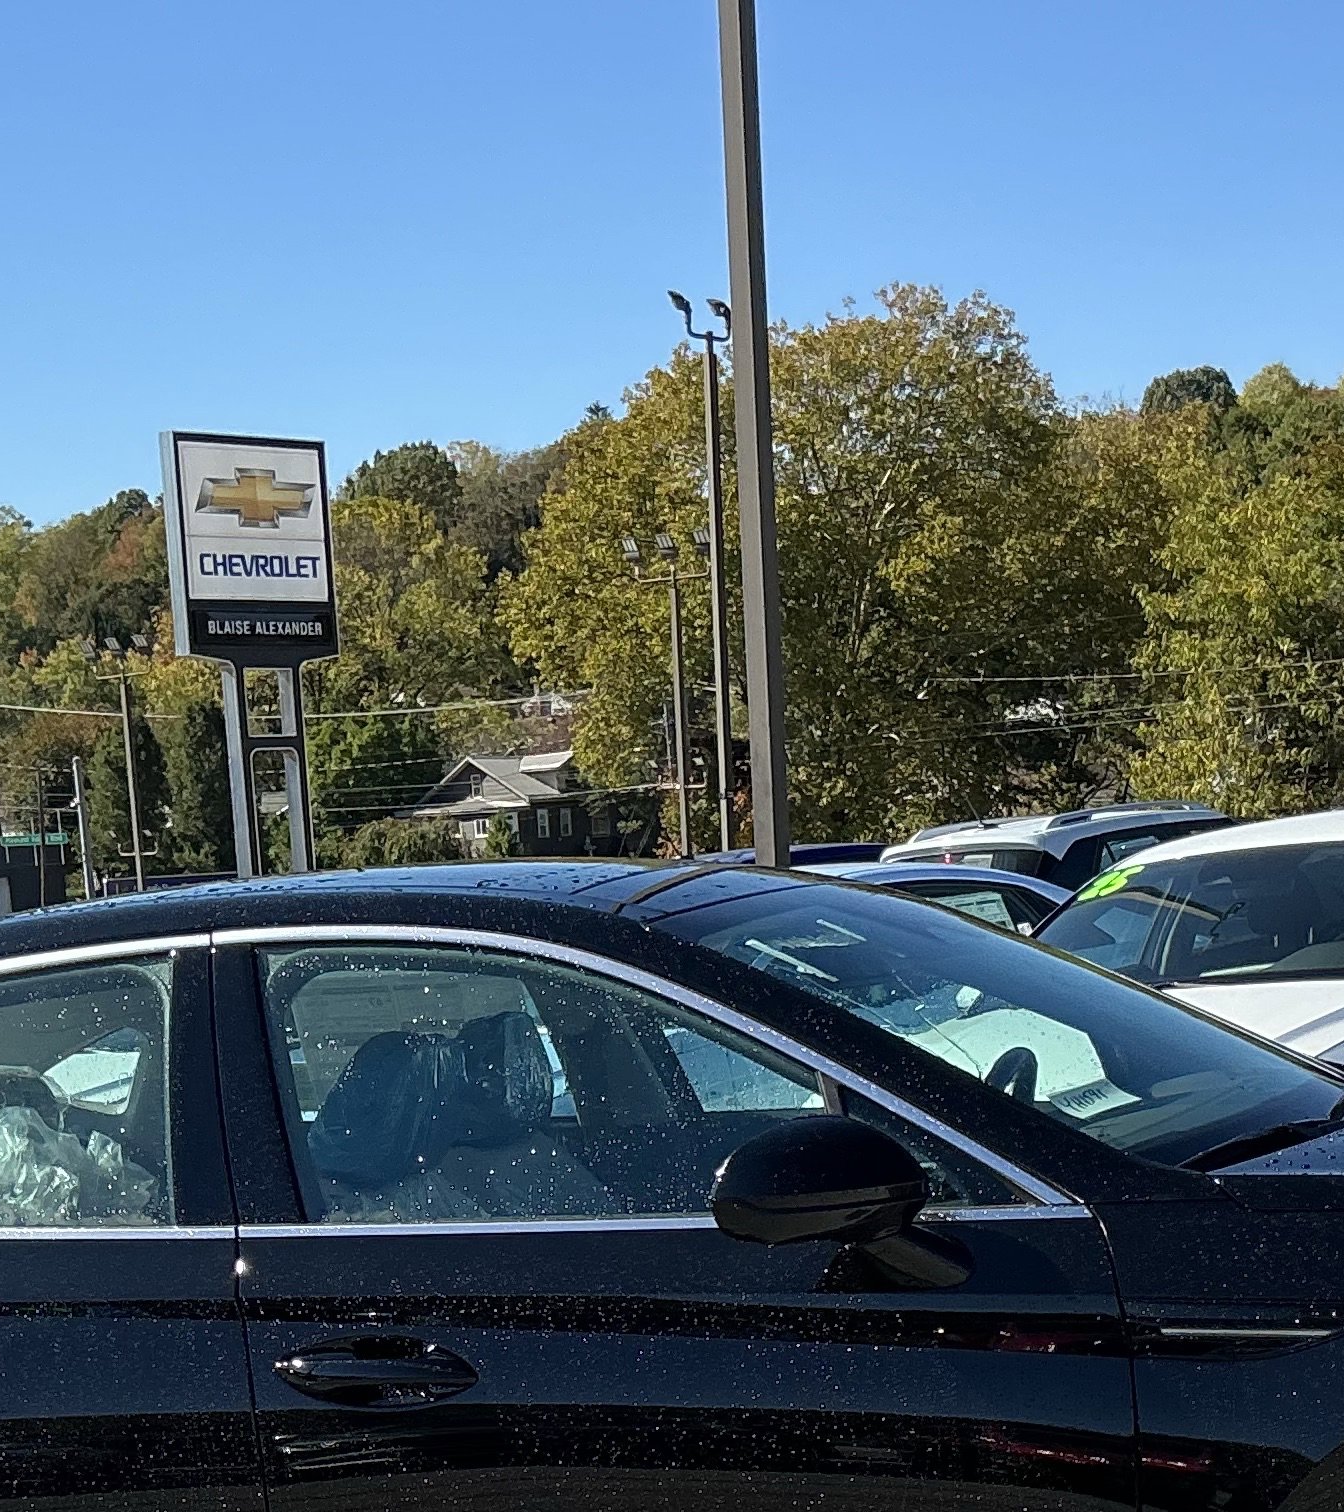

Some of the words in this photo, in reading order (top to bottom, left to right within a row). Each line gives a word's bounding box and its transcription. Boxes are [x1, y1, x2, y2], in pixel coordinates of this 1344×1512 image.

[199, 552, 321, 579] CHEVROLET
[207, 620, 251, 635] BLAISE
[255, 620, 323, 636] ALEXANDER
